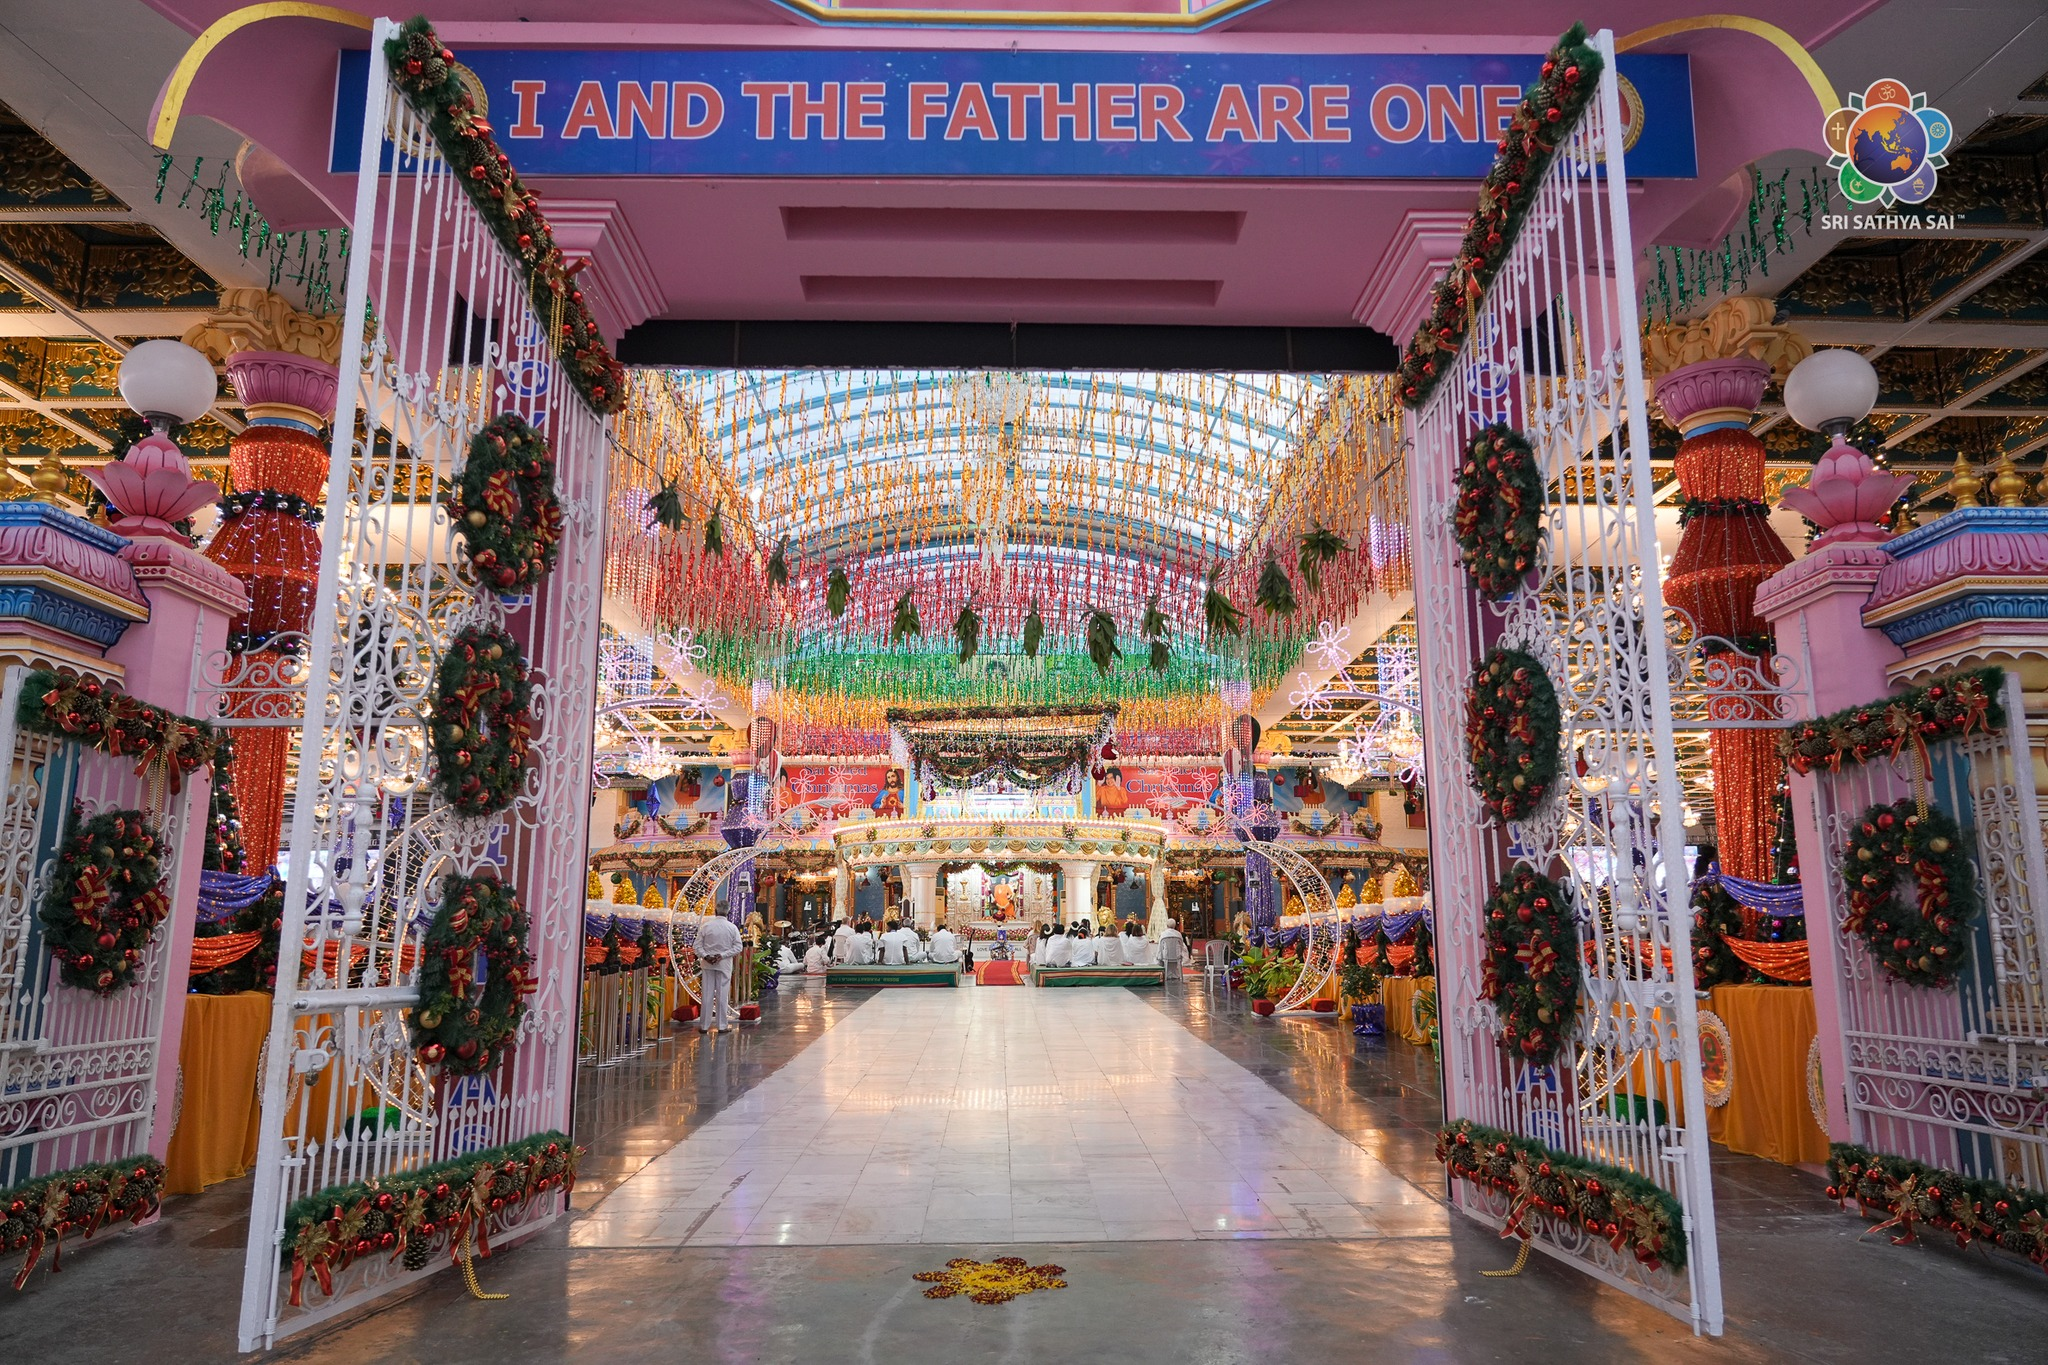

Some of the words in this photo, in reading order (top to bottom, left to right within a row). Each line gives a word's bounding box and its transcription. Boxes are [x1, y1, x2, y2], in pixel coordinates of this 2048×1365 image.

[510, 80, 545, 139] I
[562, 80, 724, 140] AND
[741, 81, 885, 140] THE
[908, 82, 1192, 142] FATHER
[1206, 84, 1351, 143] ARE
[1369, 83, 1522, 144] ONE
